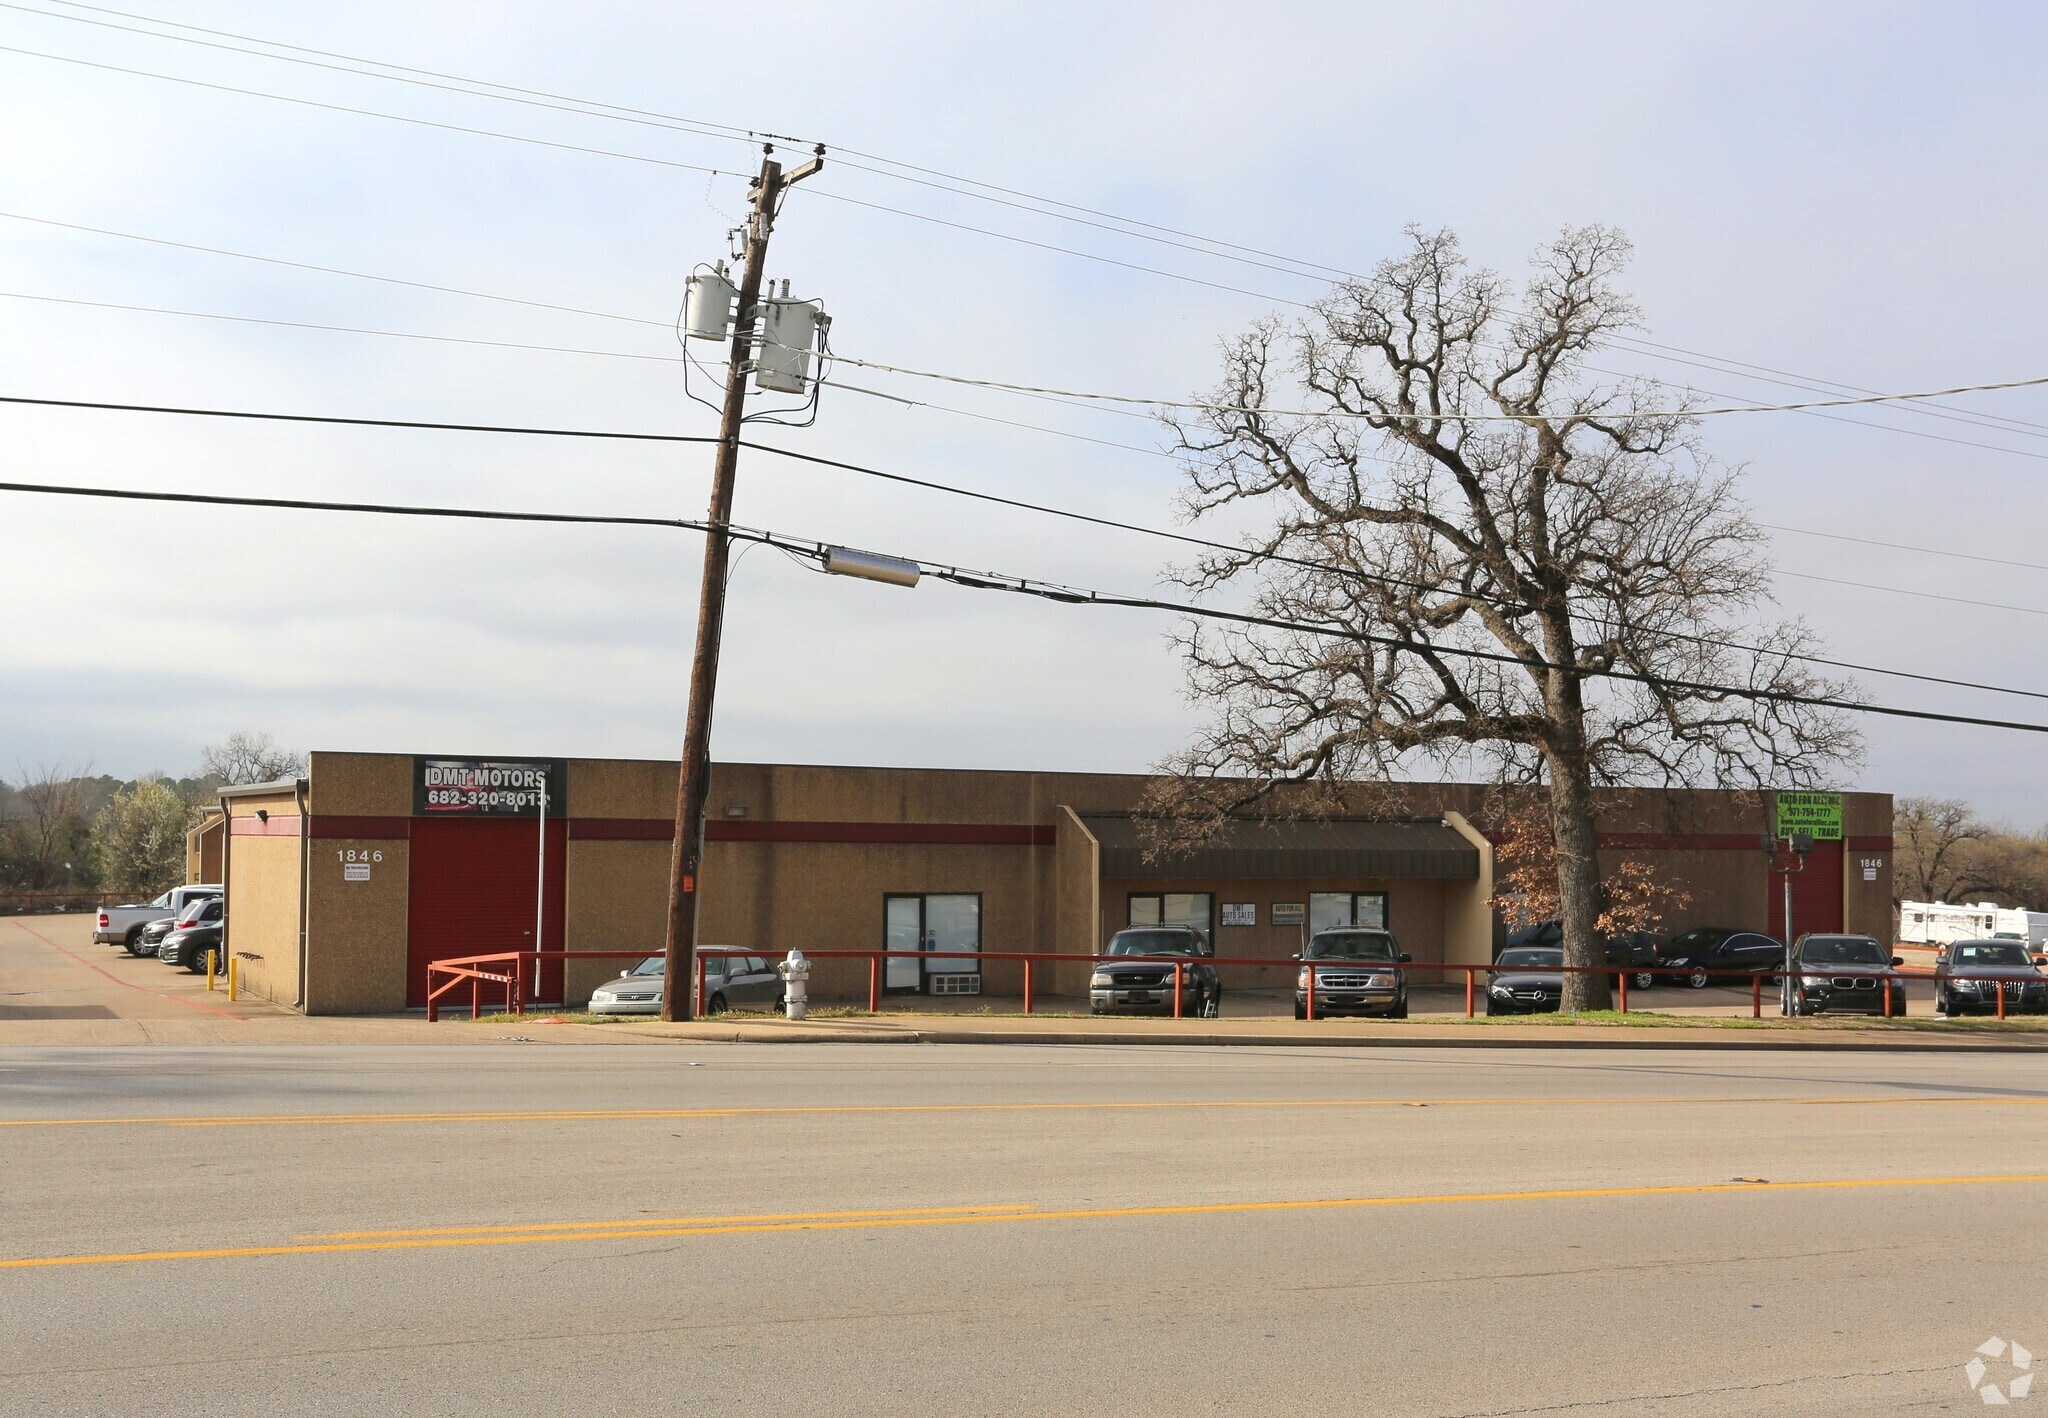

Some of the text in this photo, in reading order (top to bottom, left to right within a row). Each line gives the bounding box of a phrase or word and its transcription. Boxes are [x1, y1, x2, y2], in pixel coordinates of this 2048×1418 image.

[430, 767, 545, 788] DMT MOTORS
[428, 790, 547, 806] 682-320-8013
[1779, 795, 1797, 804] AUTO
[1798, 795, 1812, 804] FOR
[1780, 827, 1795, 836] BUY
[1818, 828, 1839, 837] TRADE
[336, 849, 383, 862] 1846
[1860, 858, 1882, 868] 1846
[1222, 911, 1254, 919] AUTO SALES
